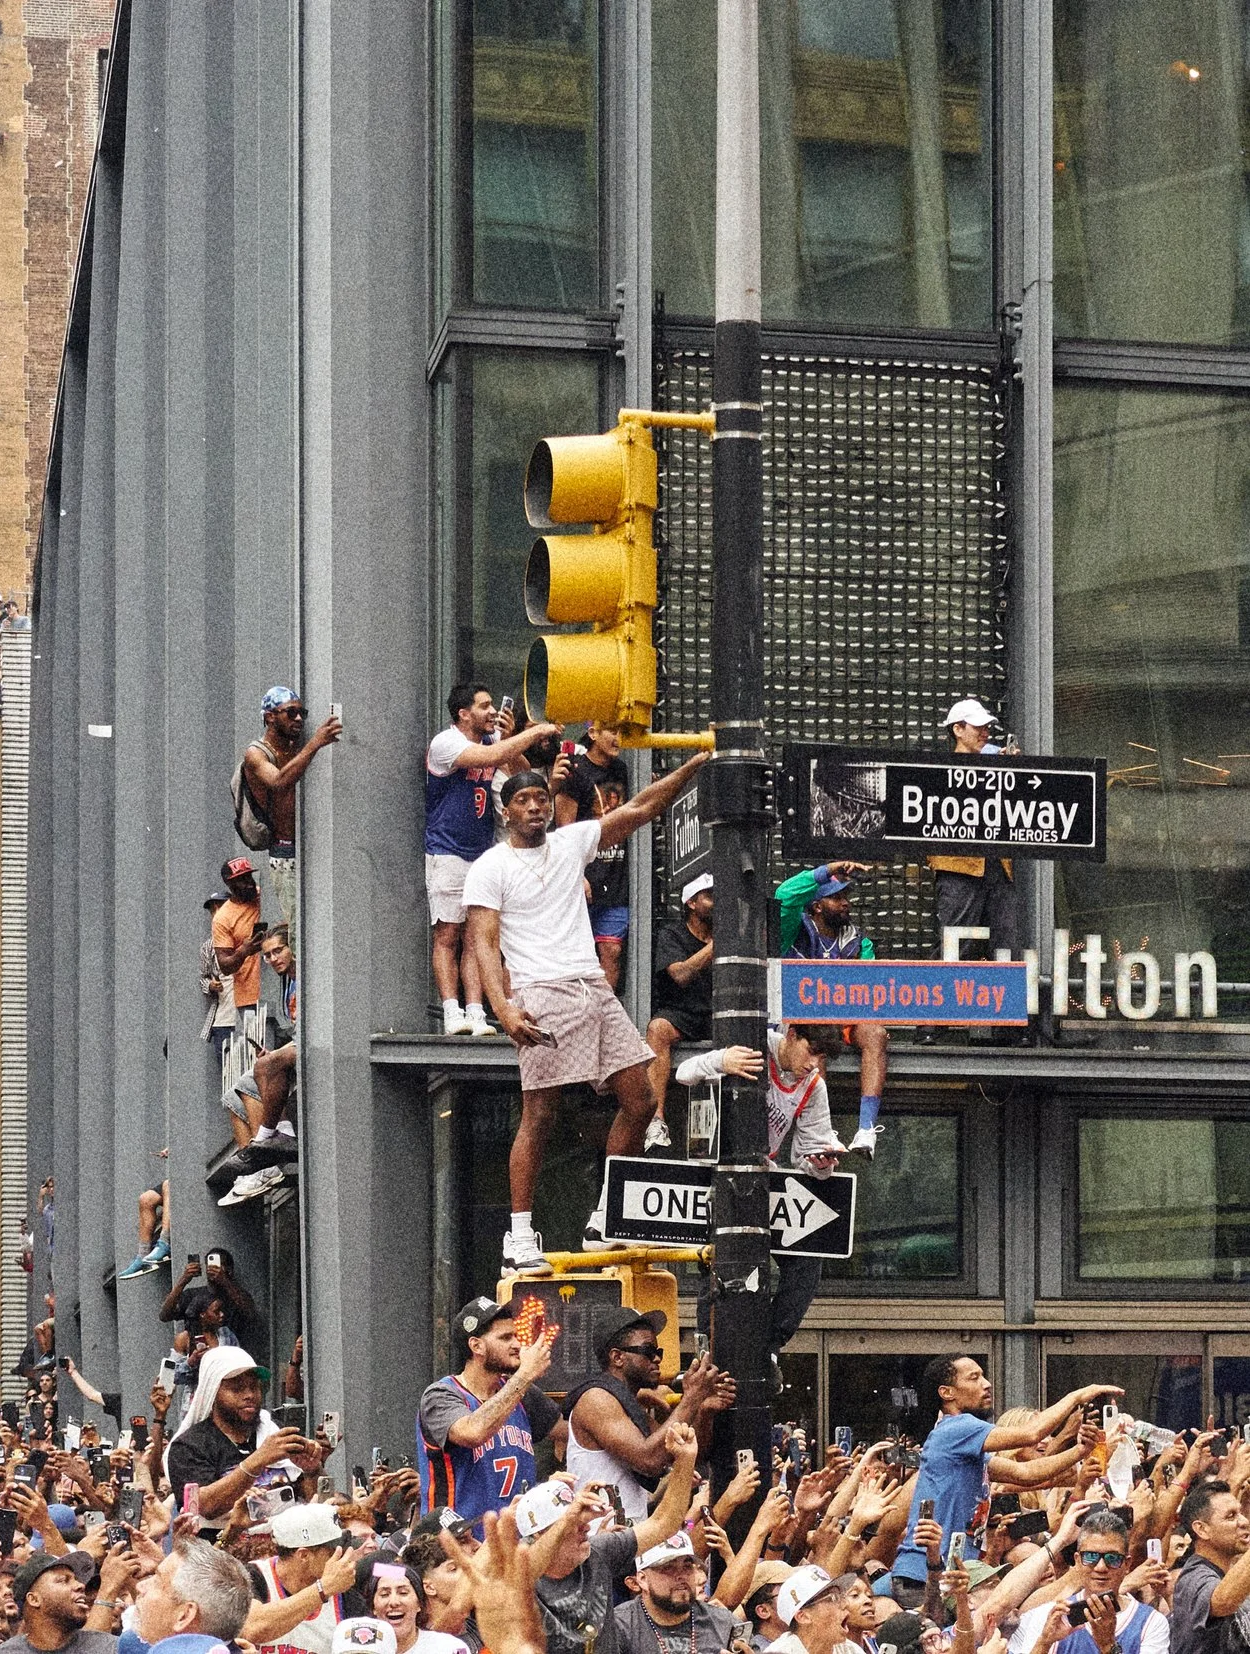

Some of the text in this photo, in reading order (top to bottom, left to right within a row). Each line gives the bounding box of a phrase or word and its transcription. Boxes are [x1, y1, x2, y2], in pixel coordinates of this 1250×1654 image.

[947, 769, 1015, 791] 190-210
[902, 785, 1079, 840] Broadway
[675, 813, 700, 861] Fulton
[922, 824, 1059, 842] CANYON OF HEROES
[798, 977, 1006, 1012] Champions Way
[643, 1187, 815, 1228] ONE AY
[472, 1425, 535, 1464] NW YORK
[493, 1456, 518, 1498] 7
